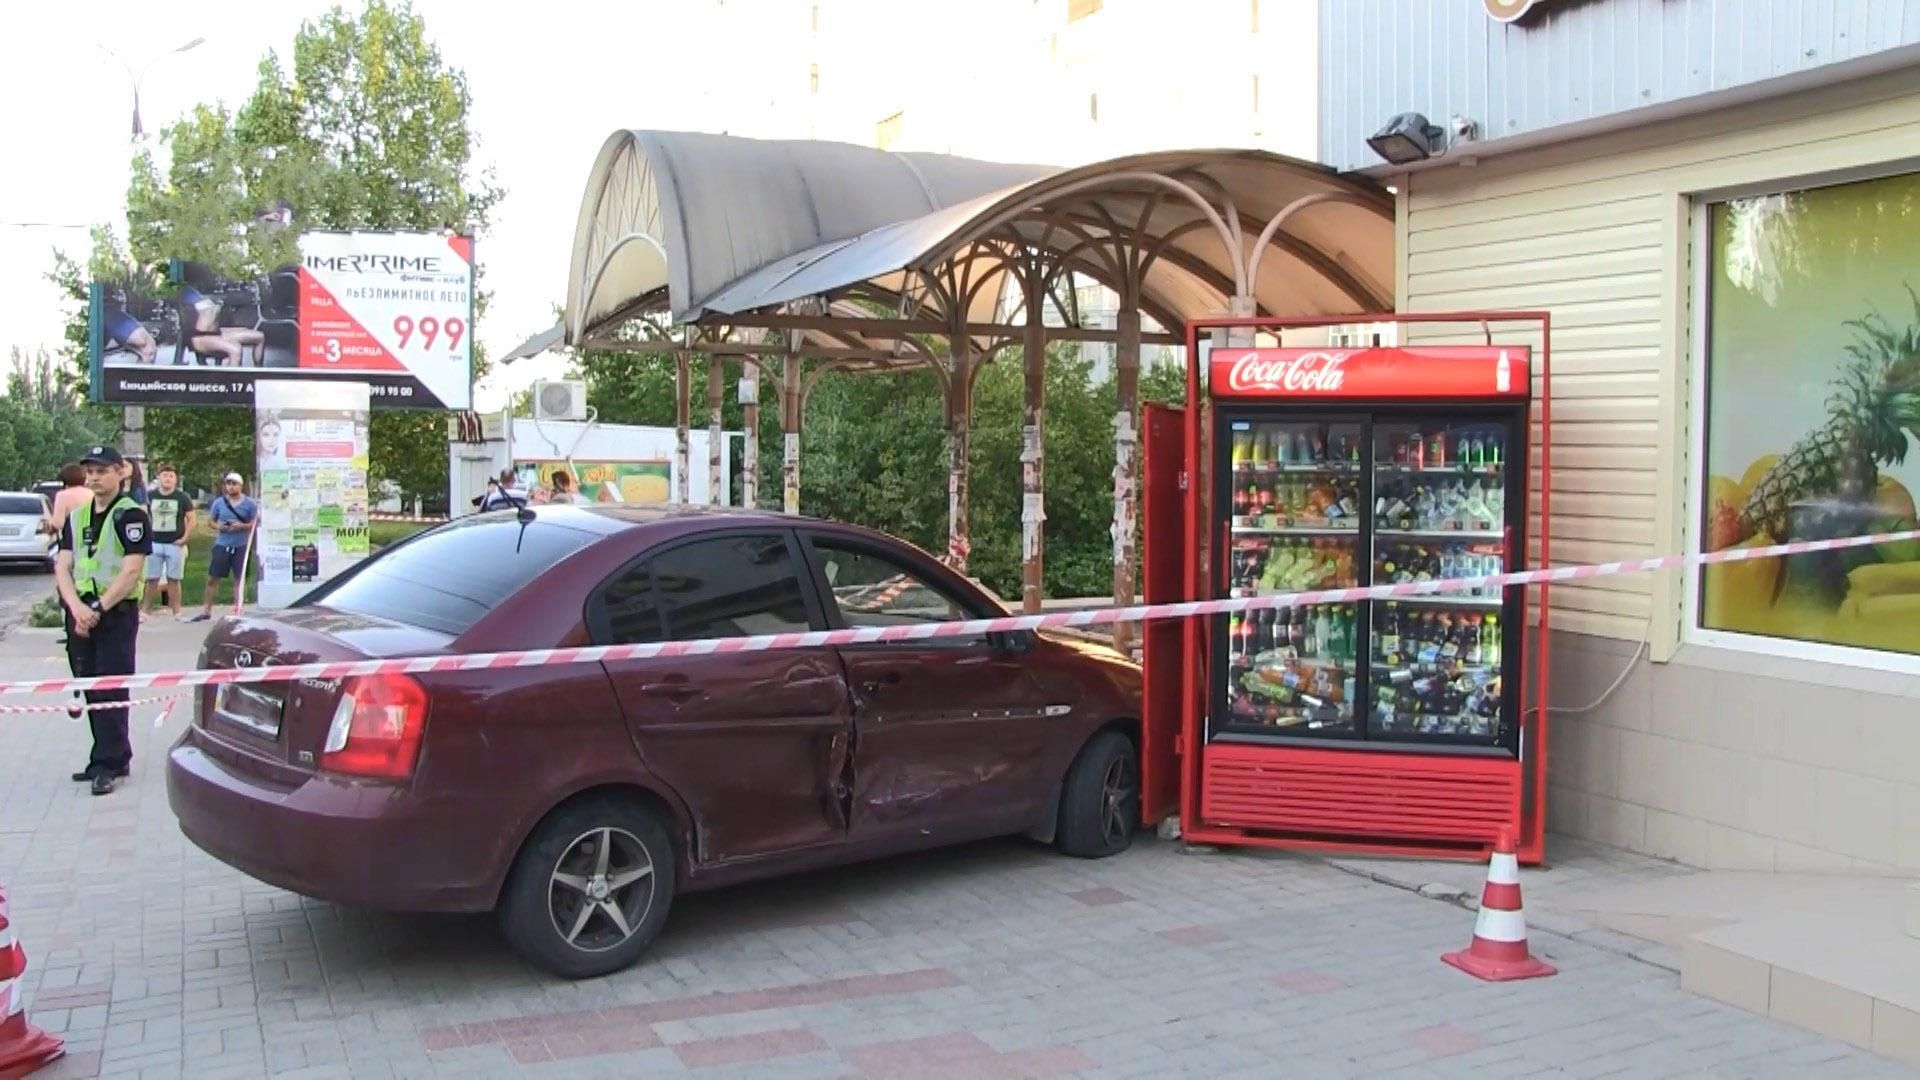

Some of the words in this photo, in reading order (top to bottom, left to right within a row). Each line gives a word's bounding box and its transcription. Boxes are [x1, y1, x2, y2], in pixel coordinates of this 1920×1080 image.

[393, 315, 465, 352] 999
[326, 338, 342, 363] 3
[232, 383, 243, 392] 17
[1229, 352, 1345, 392] Coca-Cola
